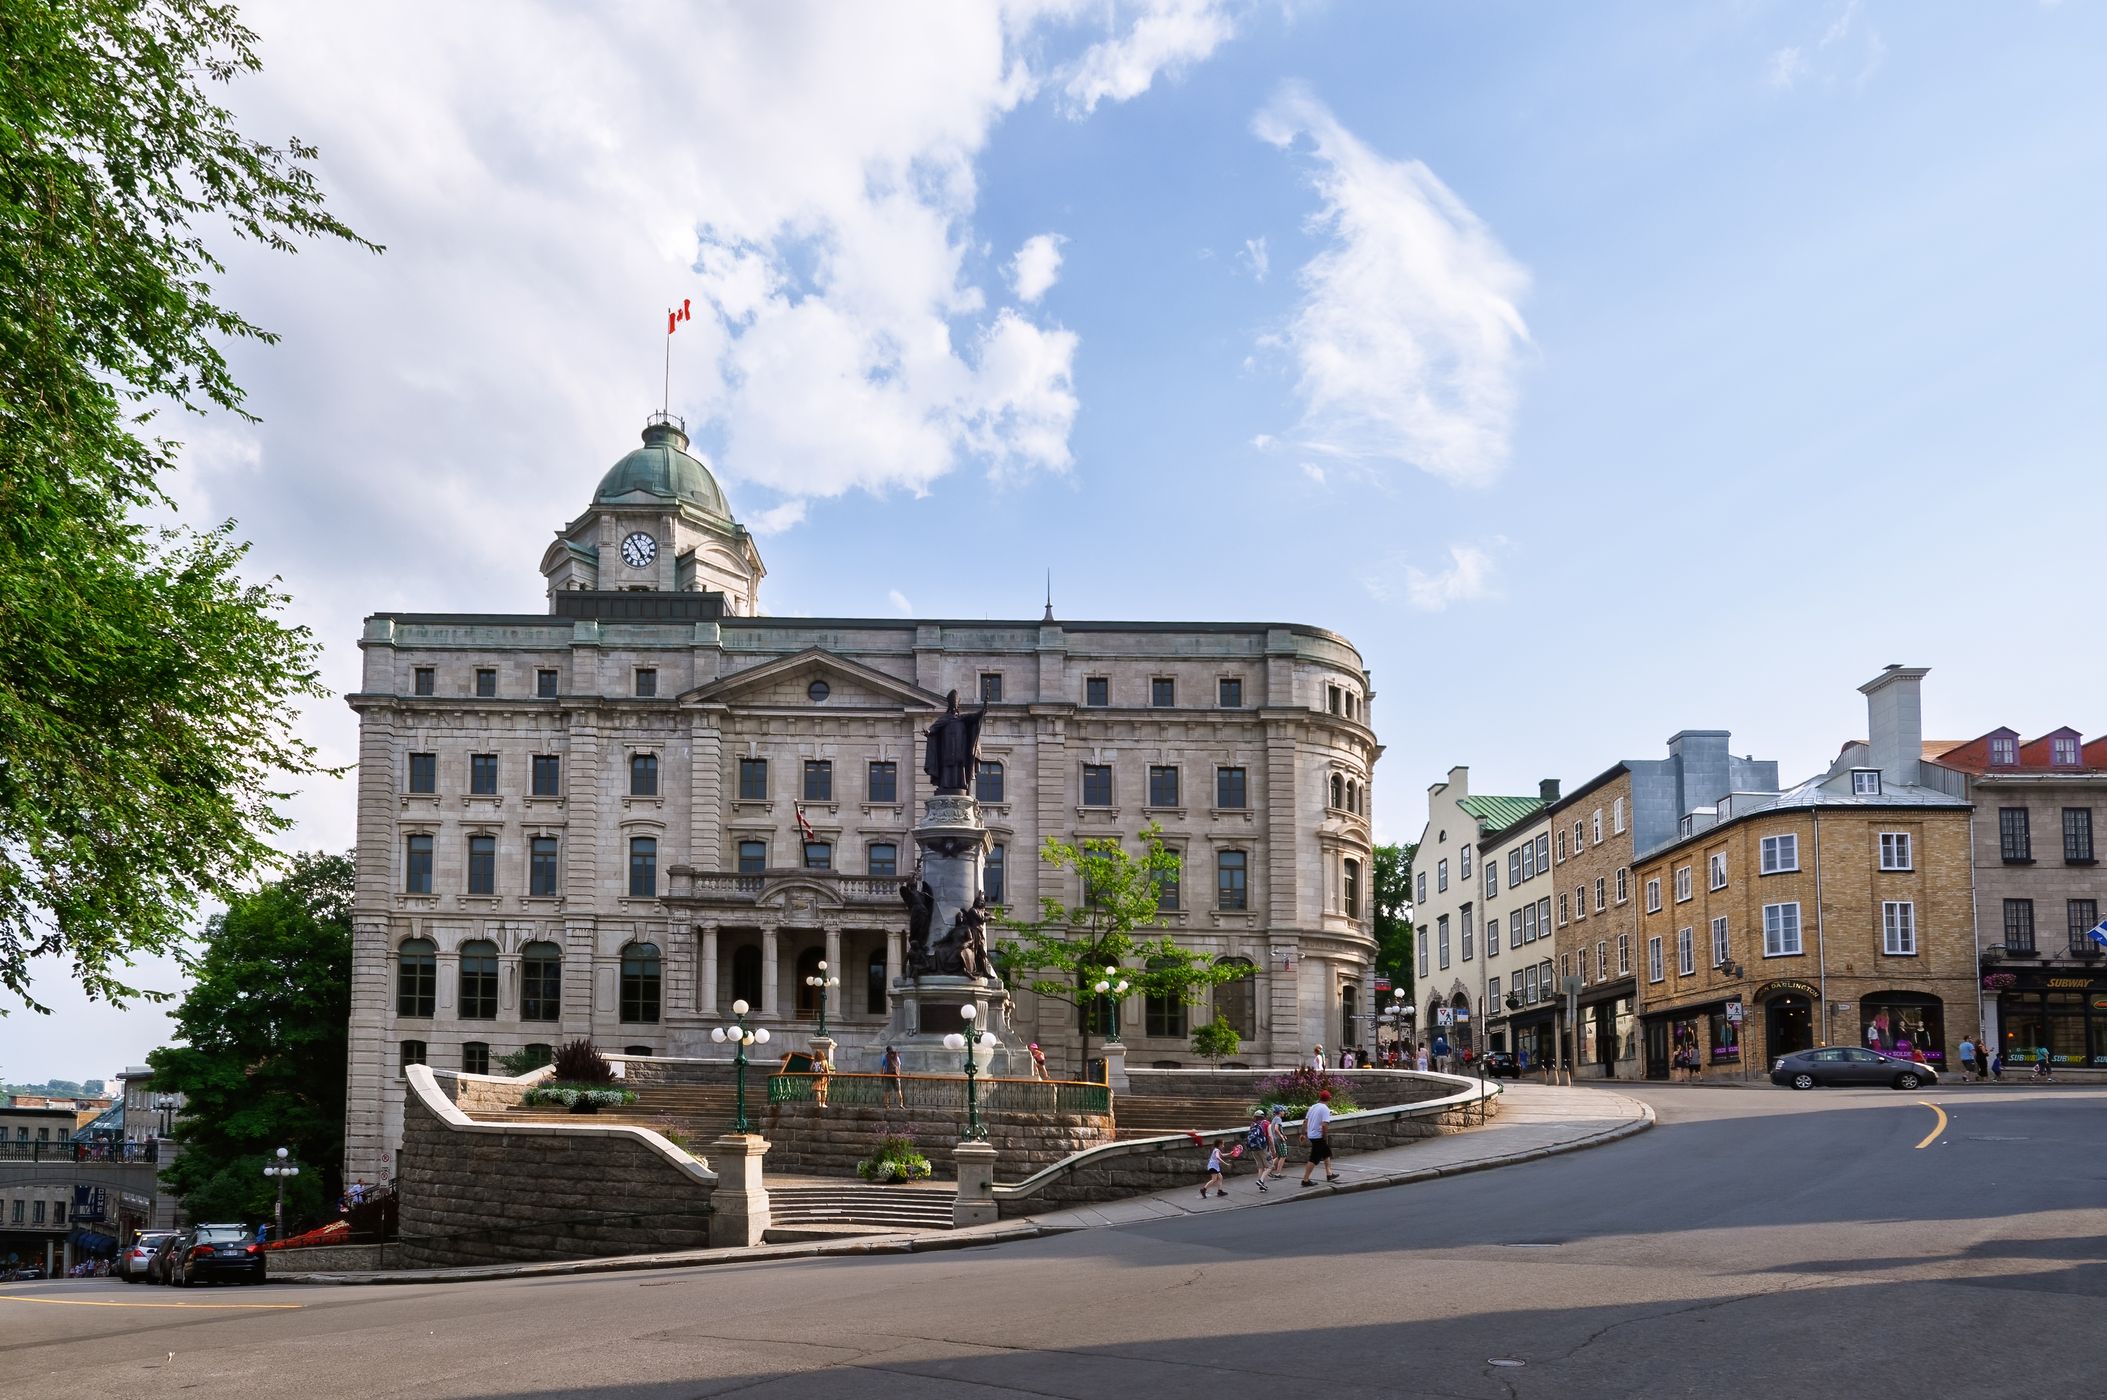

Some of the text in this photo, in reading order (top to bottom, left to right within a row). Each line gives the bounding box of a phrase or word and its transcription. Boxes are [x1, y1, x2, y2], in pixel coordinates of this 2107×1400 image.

[2047, 979, 2095, 988] SUBWAY
[1771, 982, 1819, 998] DARLINGTON
[2008, 1054, 2038, 1062] SUBWA
[2051, 1055, 2087, 1063] SUBWAY
